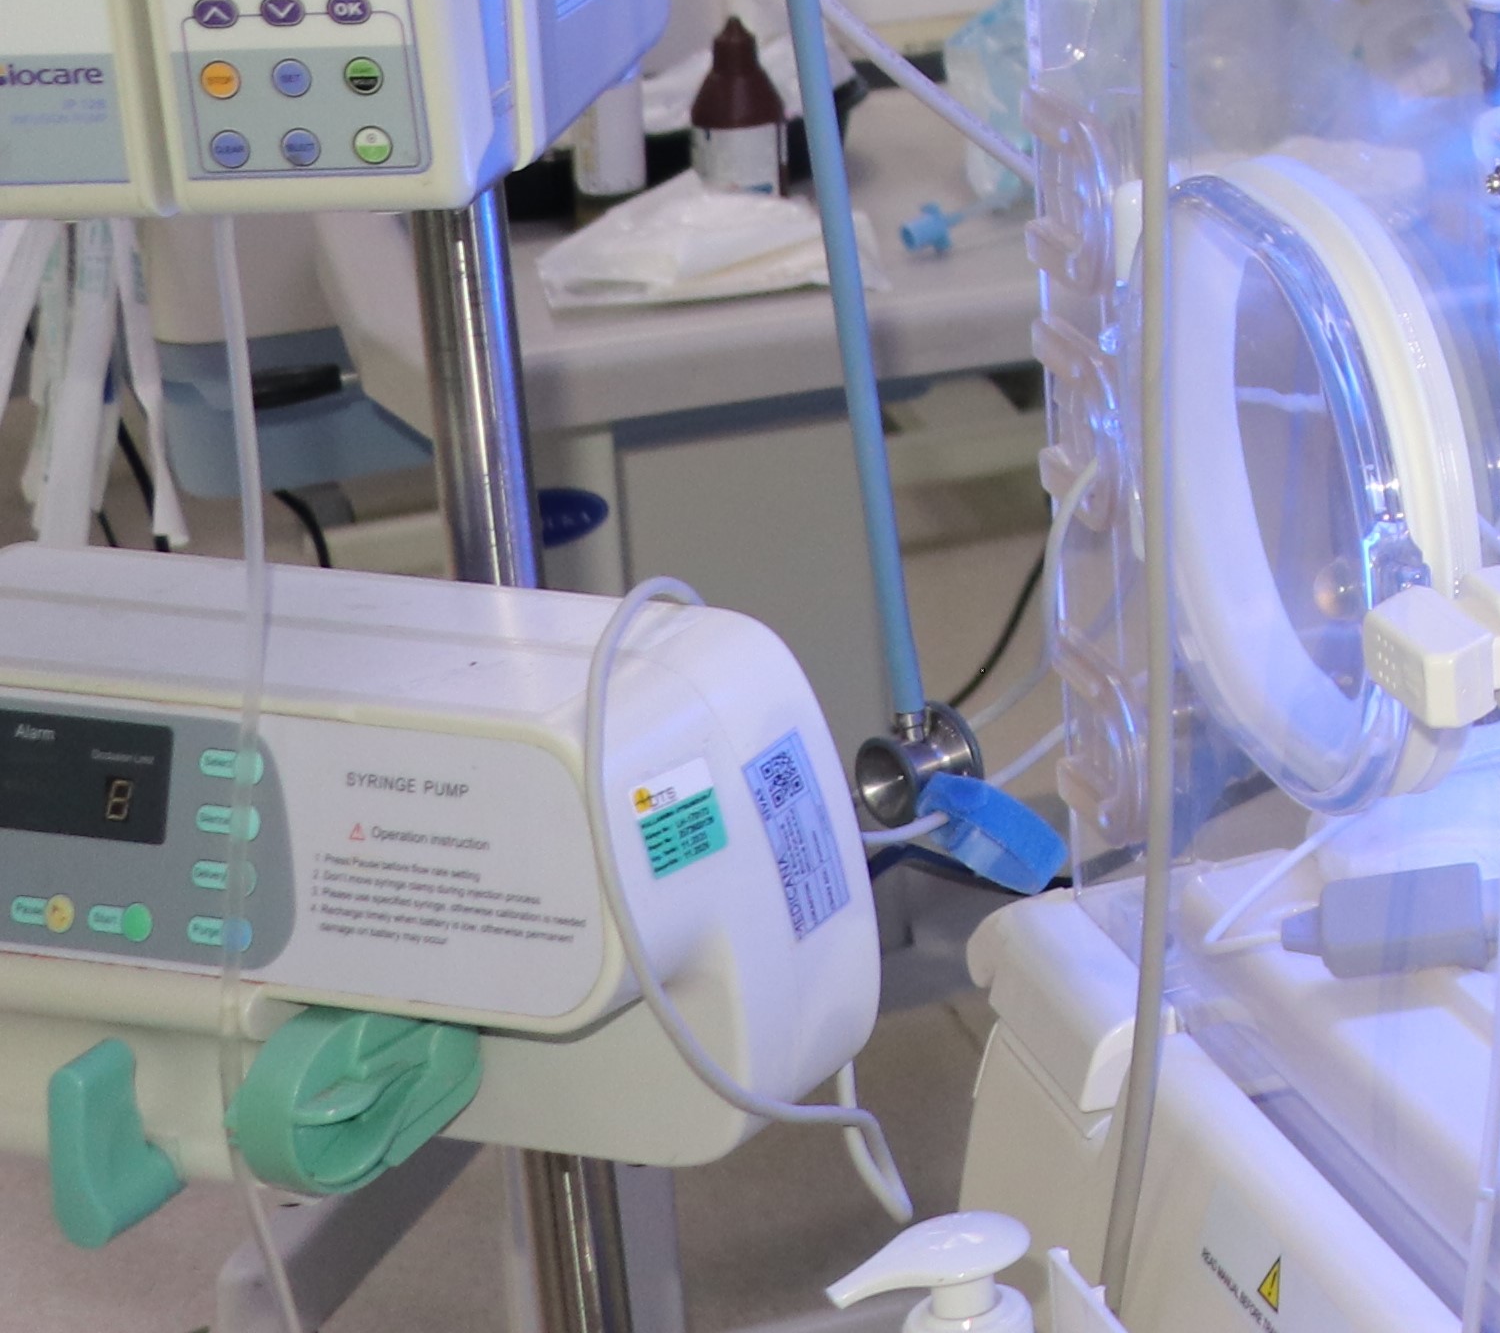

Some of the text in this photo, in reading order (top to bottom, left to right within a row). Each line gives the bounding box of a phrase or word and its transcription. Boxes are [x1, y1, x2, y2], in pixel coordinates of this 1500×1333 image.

[333, 2, 363, 18] OK
[14, 723, 56, 741] Alarm
[346, 771, 470, 798] SYRINGE PUMP
[371, 826, 490, 851] Operation instruction
